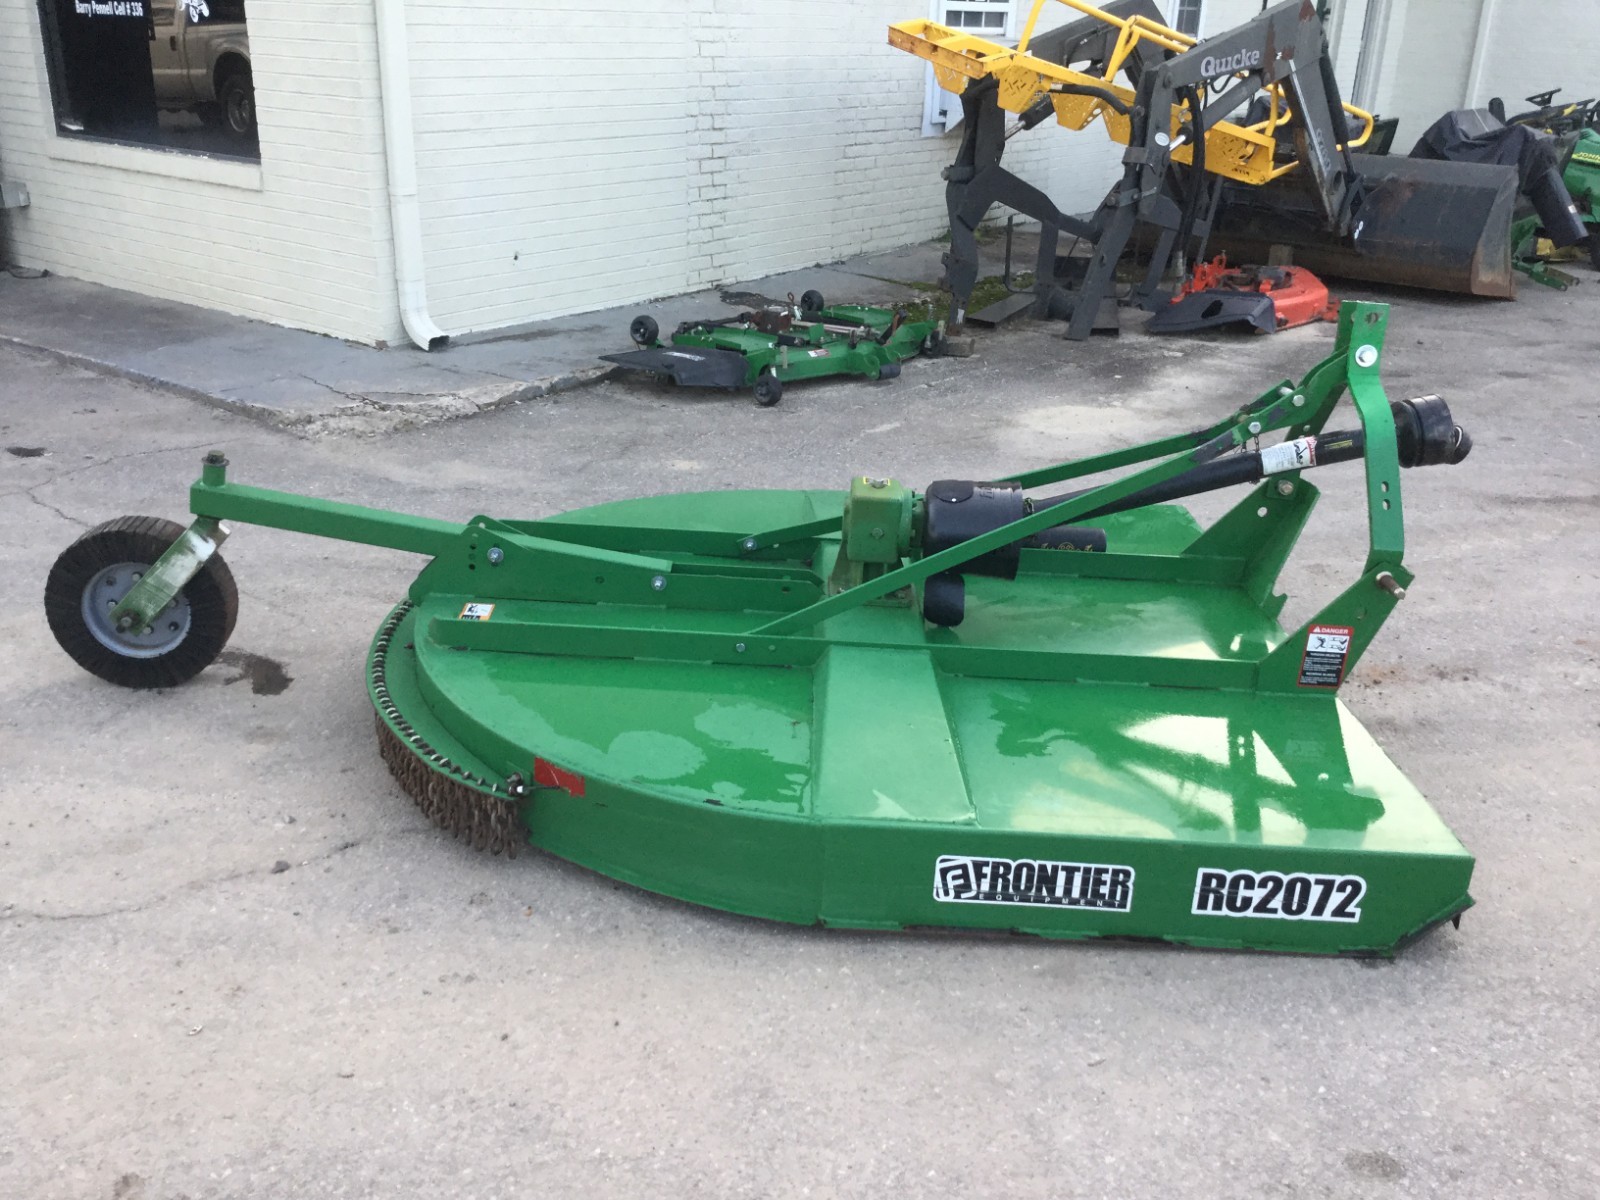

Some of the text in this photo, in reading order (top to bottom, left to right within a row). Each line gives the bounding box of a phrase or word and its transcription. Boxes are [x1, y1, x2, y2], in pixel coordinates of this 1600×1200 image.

[113, 1, 126, 15] Cell
[1200, 48, 1260, 77] Quicke
[971, 861, 1132, 901] FRONTIER
[1195, 871, 1363, 919] RC2072
[979, 894, 1120, 907] EQUIPMENT
